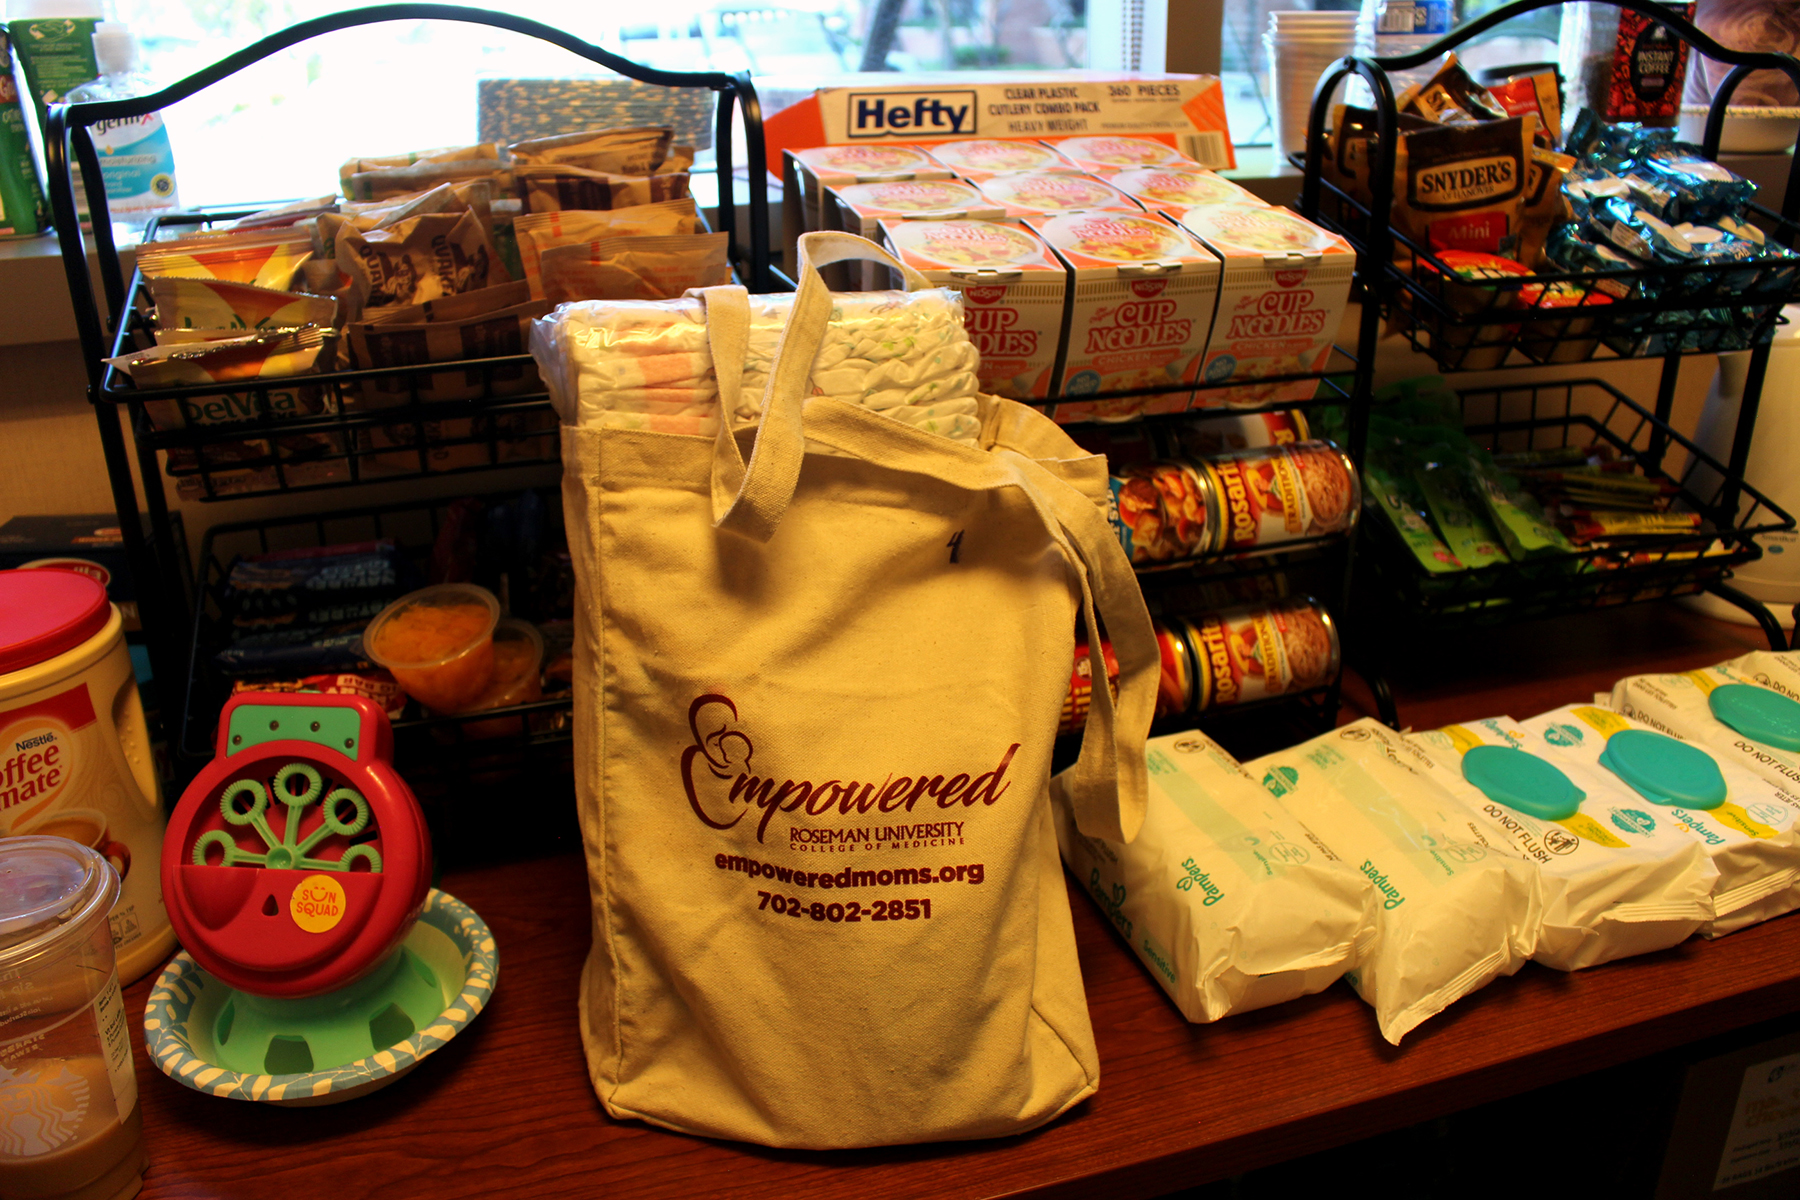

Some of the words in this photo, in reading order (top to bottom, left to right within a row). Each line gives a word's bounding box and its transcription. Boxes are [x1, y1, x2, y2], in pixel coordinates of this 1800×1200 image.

[1637, 52, 1675, 62] INSTANT
[1638, 63, 1673, 74] COFFEE
[1004, 88, 1036, 100] CLEAR
[1039, 86, 1079, 99] PLASTIC
[1108, 85, 1131, 97] 360
[1138, 84, 1181, 96] PIECES
[857, 98, 967, 133] Hefty
[988, 103, 1032, 116] CUTLERY
[1035, 102, 1073, 115] COMBO
[1074, 102, 1100, 114] PACK
[1008, 120, 1044, 133] HEAVY
[1048, 118, 1088, 132] WEIGHT
[1421, 160, 1513, 194] SNYDER'S
[1448, 220, 1490, 240] Mini
[970, 287, 1003, 299] NISSIN
[1134, 280, 1164, 293] NISSIN
[1115, 299, 1177, 327] CUP
[1257, 289, 1314, 316] CUP
[1084, 318, 1192, 354] NOODLES
[1225, 309, 1326, 340] NOODLES
[1099, 353, 1151, 365] CHICKEN
[946, 529, 965, 564] 4
[1734, 740, 1754, 753] DO
[1752, 751, 1778, 766] NOT
[681, 693, 1021, 844] Empowered
[789, 826, 869, 845] ROSEMAN
[874, 821, 965, 843] UNIVERSITY
[1483, 804, 1503, 823] DO
[1498, 816, 1525, 835] NOT
[1517, 832, 1553, 865] FLUSH
[1671, 808, 1726, 846] Pampers
[1725, 810, 1760, 837] Sensitive
[789, 843, 855, 853] COLLEGE
[864, 842, 881, 851] OF
[891, 837, 966, 850] MEDICINE
[714, 852, 985, 889] empoweredmoms.org
[1429, 849, 1455, 877] Sensitive
[302, 887, 337, 904] SUN
[1181, 857, 1226, 907] Pampers
[1359, 859, 1406, 911] Pampers
[296, 901, 339, 918] SQUAD
[757, 890, 932, 923] 702-802-2851
[1089, 867, 1133, 939] Pampers
[1143, 939, 1176, 984] Sensitive
